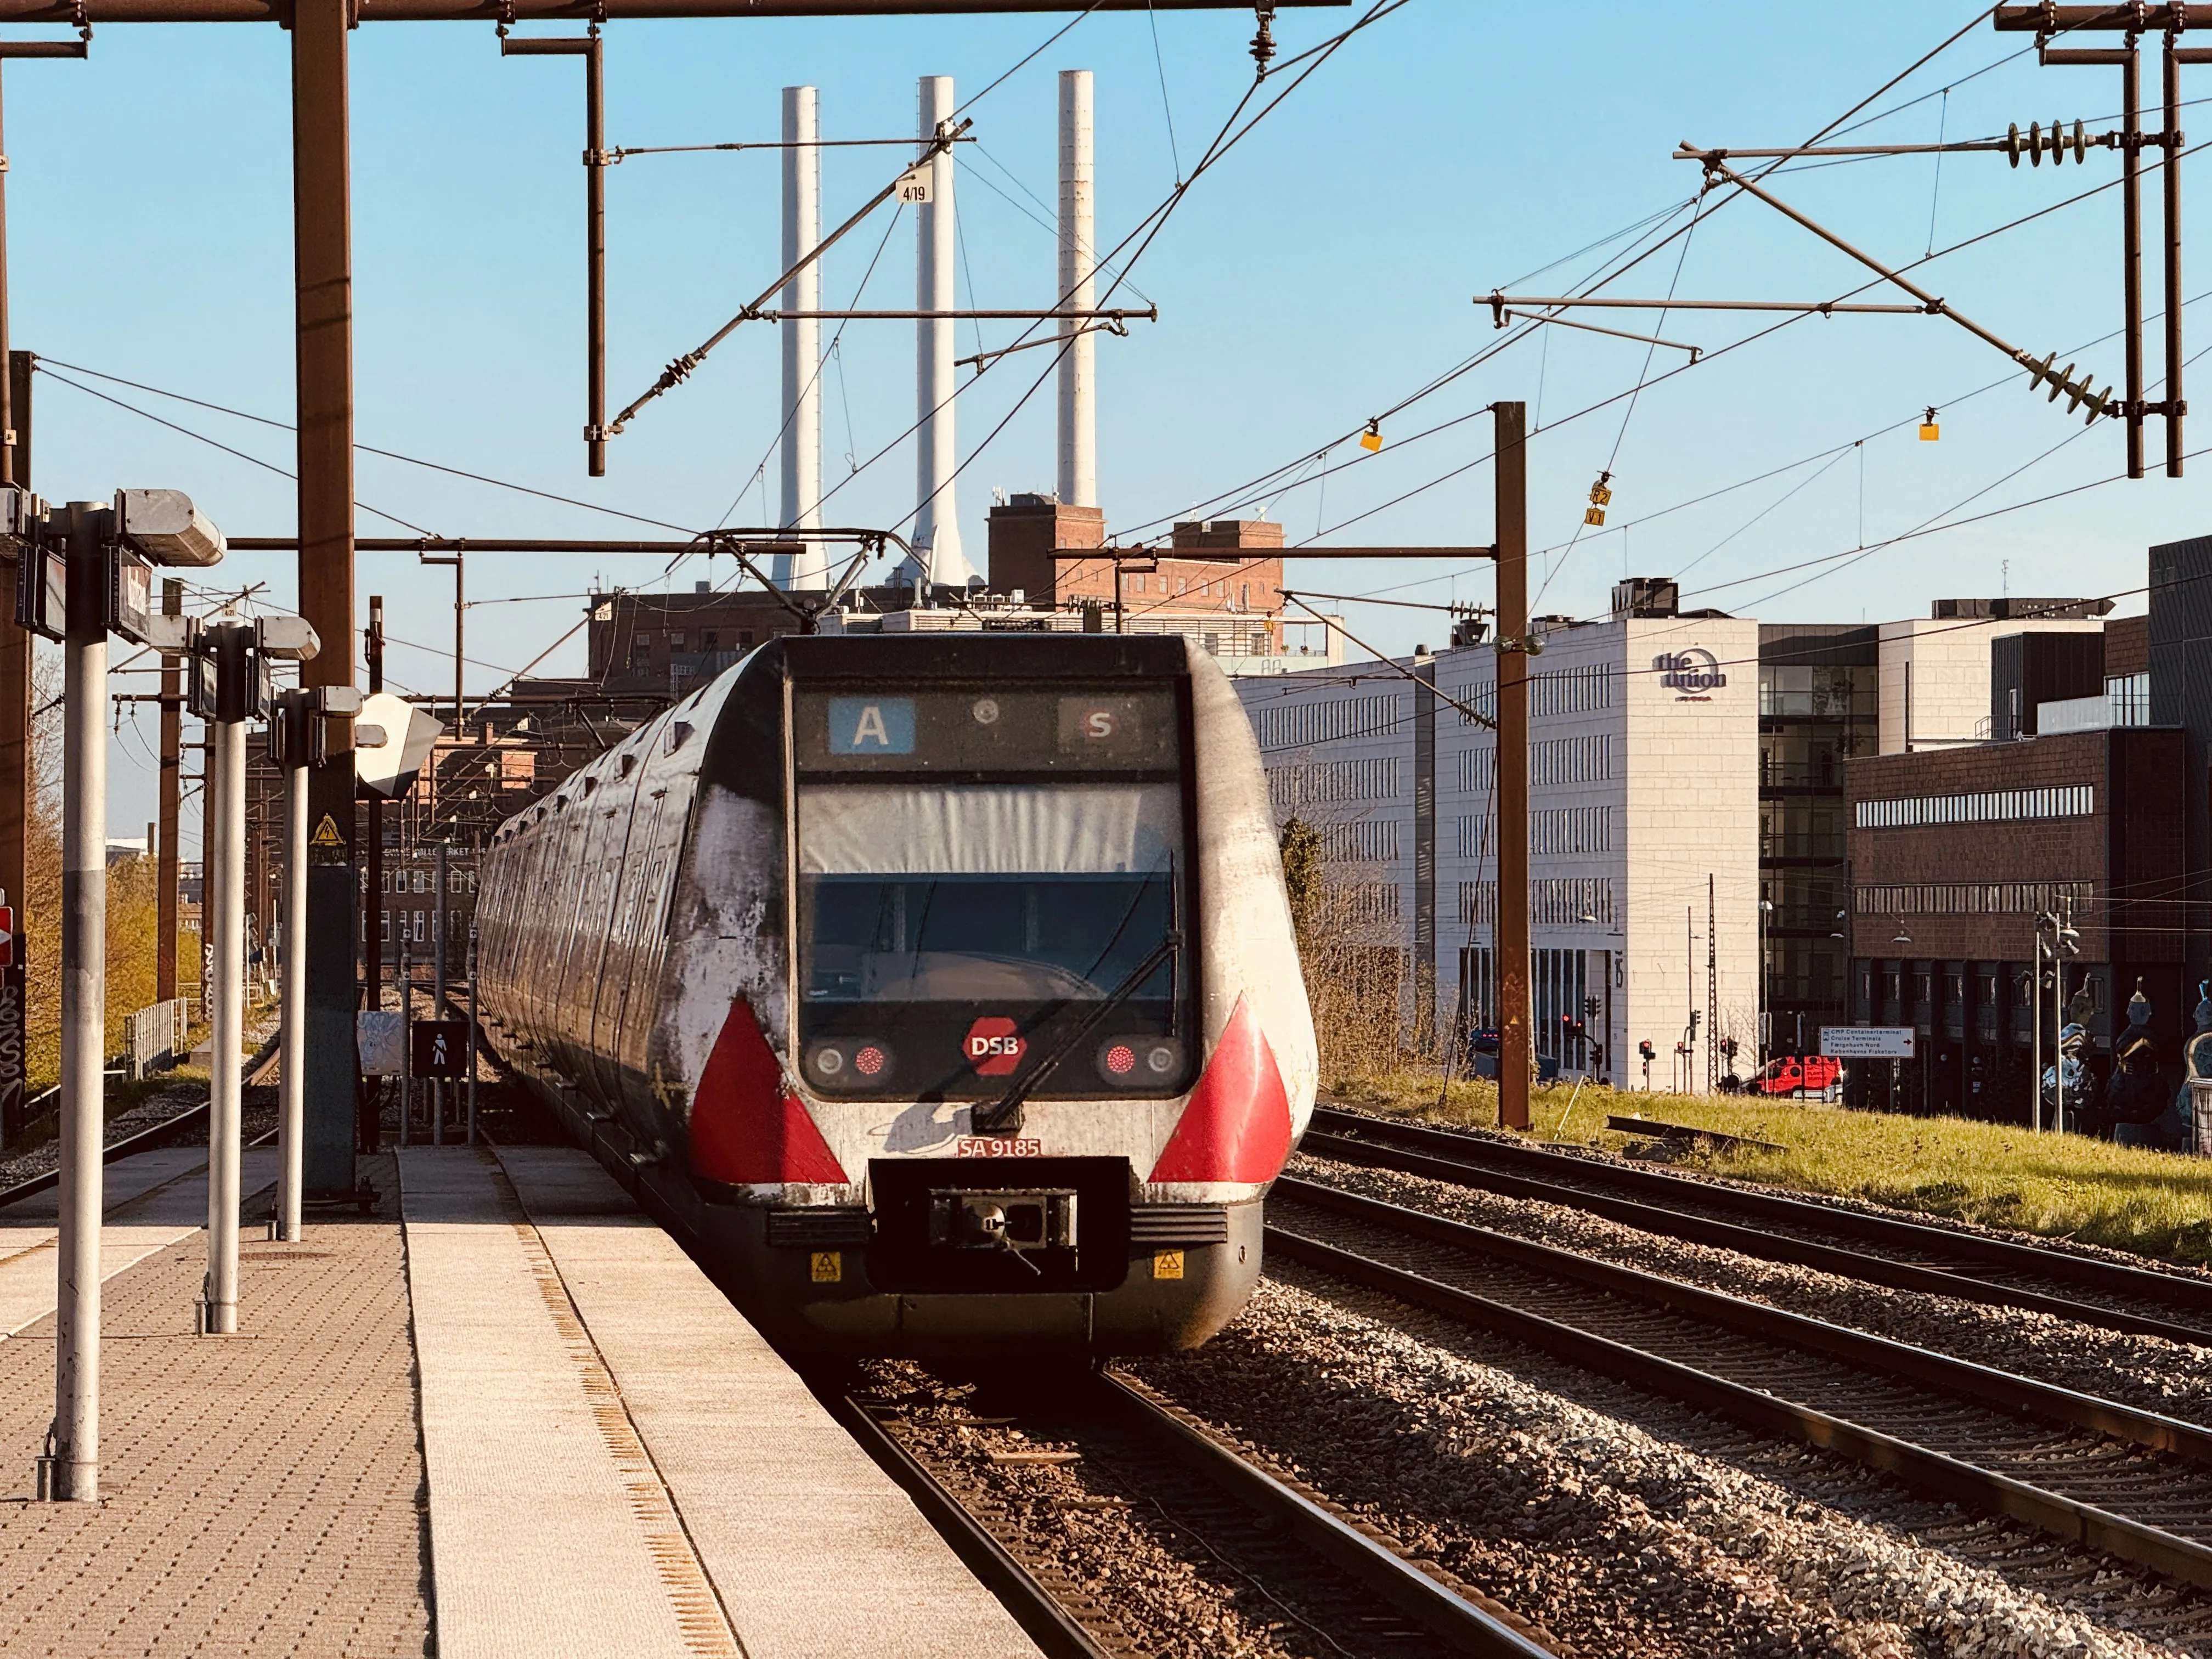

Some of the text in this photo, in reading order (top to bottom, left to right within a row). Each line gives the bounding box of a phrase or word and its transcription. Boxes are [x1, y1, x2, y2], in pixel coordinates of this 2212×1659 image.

[903, 187, 925, 201] 4/19
[1654, 652, 1692, 671] the
[1661, 668, 1726, 687] union
[853, 706, 889, 745] A
[1089, 712, 1111, 737] S
[972, 1036, 1019, 1056] DSB
[960, 1140, 1039, 1158] SA 9185
